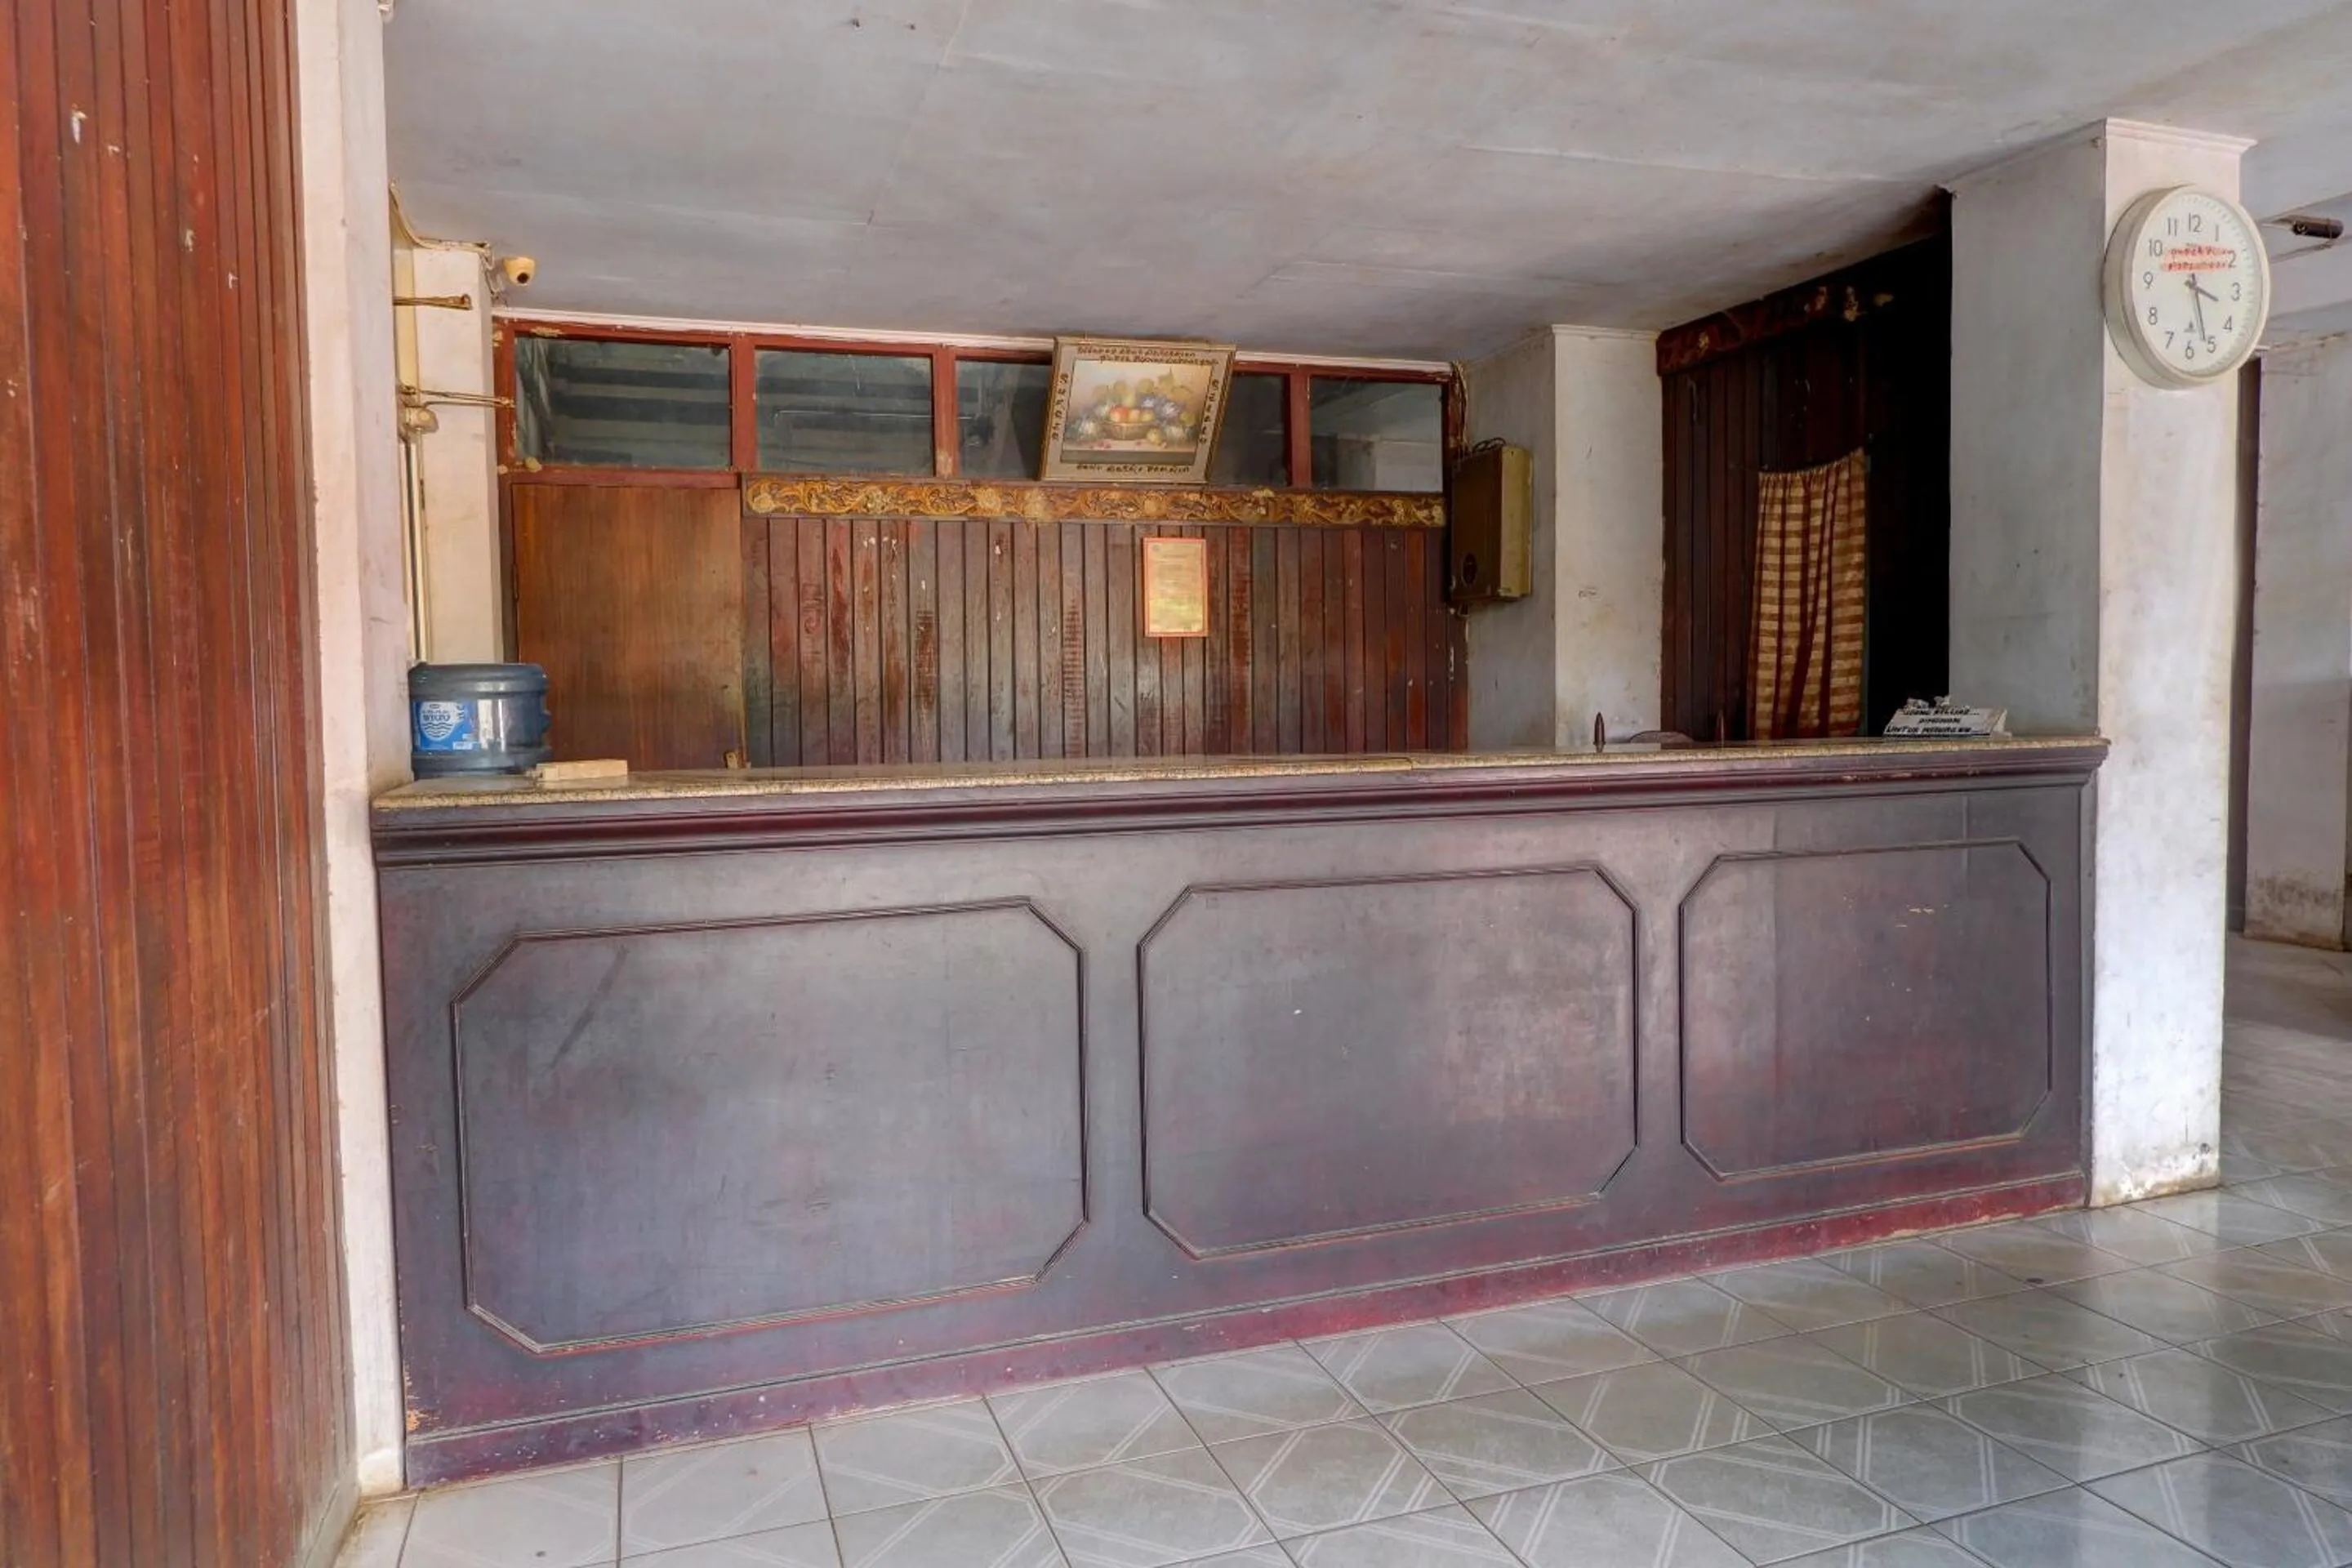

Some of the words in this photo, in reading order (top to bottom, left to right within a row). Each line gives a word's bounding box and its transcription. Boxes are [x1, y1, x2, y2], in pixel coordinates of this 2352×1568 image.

[2167, 218, 2179, 235] 11
[2188, 212, 2201, 233] 12
[2215, 225, 2220, 242] 1
[2149, 238, 2163, 257] 10
[2227, 250, 2238, 269] 2
[2142, 271, 2154, 289] 9
[2230, 282, 2242, 301] 3
[2148, 307, 2158, 326] 8
[2222, 315, 2233, 332] 4
[2164, 331, 2175, 350] 7
[2207, 336, 2217, 354] 5
[2185, 341, 2194, 360] 6
